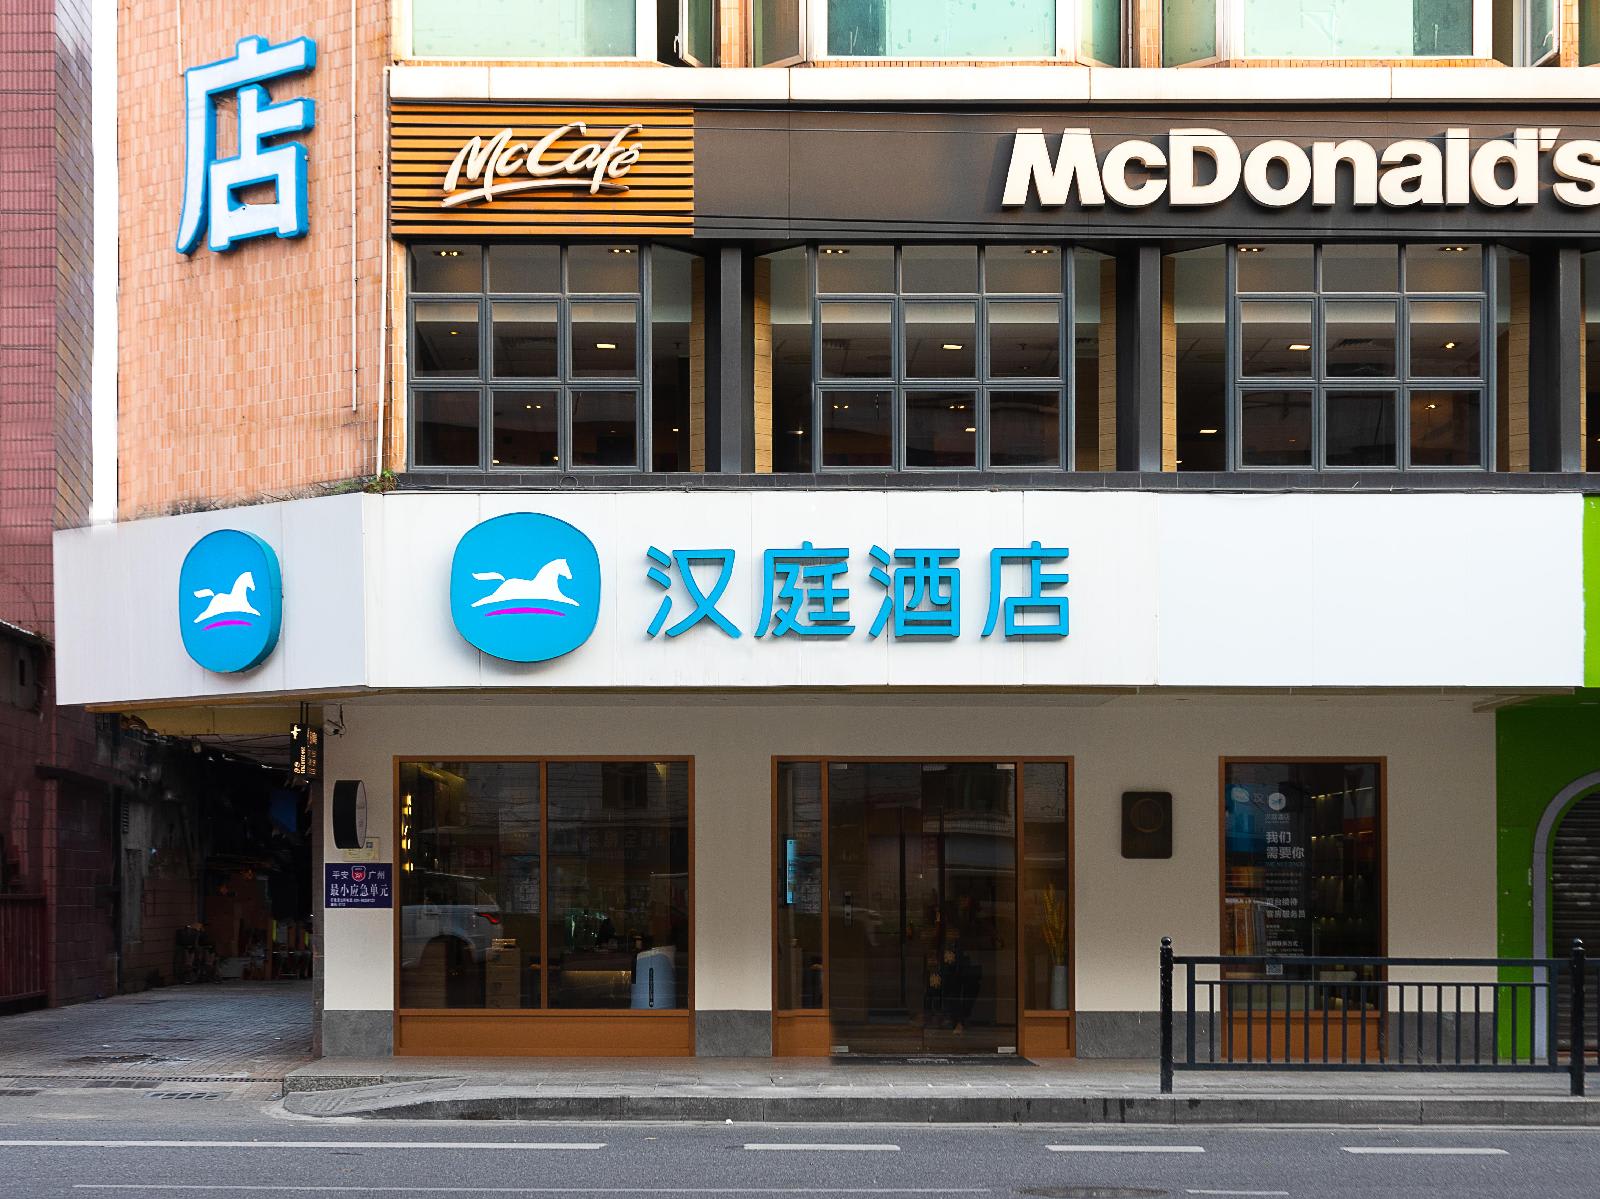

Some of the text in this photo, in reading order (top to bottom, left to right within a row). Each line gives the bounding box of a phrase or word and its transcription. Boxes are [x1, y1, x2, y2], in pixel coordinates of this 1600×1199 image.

[176, 34, 317, 255] 店
[1000, 126, 1600, 207] McDonald's
[646, 540, 1070, 641] 汉庭酒店
[1265, 831, 1291, 843] 我们
[1266, 846, 1305, 859] 需要你
[332, 870, 349, 880] 平安
[368, 870, 385, 880] 广州
[330, 884, 389, 897] 最小应急单元
